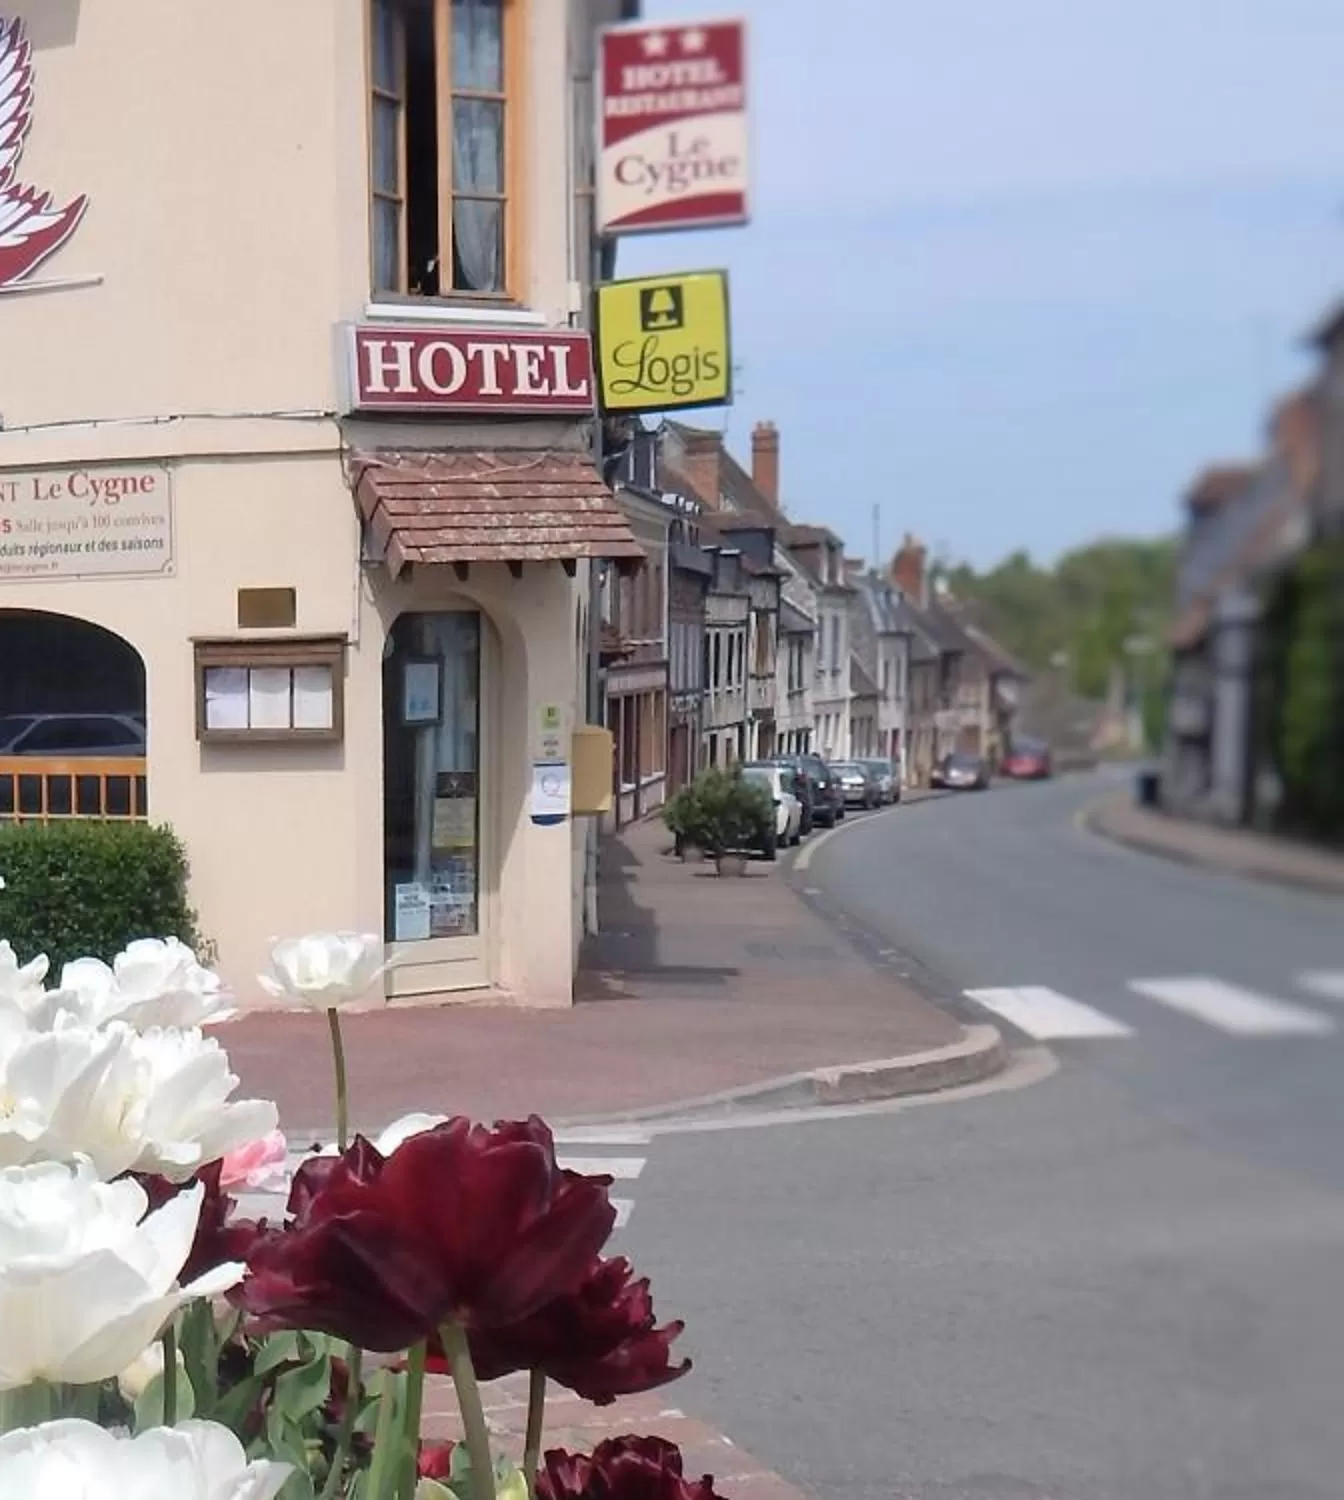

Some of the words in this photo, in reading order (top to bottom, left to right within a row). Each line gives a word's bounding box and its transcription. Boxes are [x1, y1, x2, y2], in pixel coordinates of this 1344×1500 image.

[622, 58, 727, 91] HOTEL
[667, 131, 711, 160] Le
[614, 155, 739, 195] Cygne
[362, 340, 588, 397] HOTEL
[609, 336, 721, 395] Logis
[32, 478, 62, 501] Le
[67, 471, 156, 506] Cygne
[28, 540, 82, 558] régionaux
[85, 539, 95, 553] et
[98, 538, 118, 552] des
[121, 536, 165, 550] saisons
